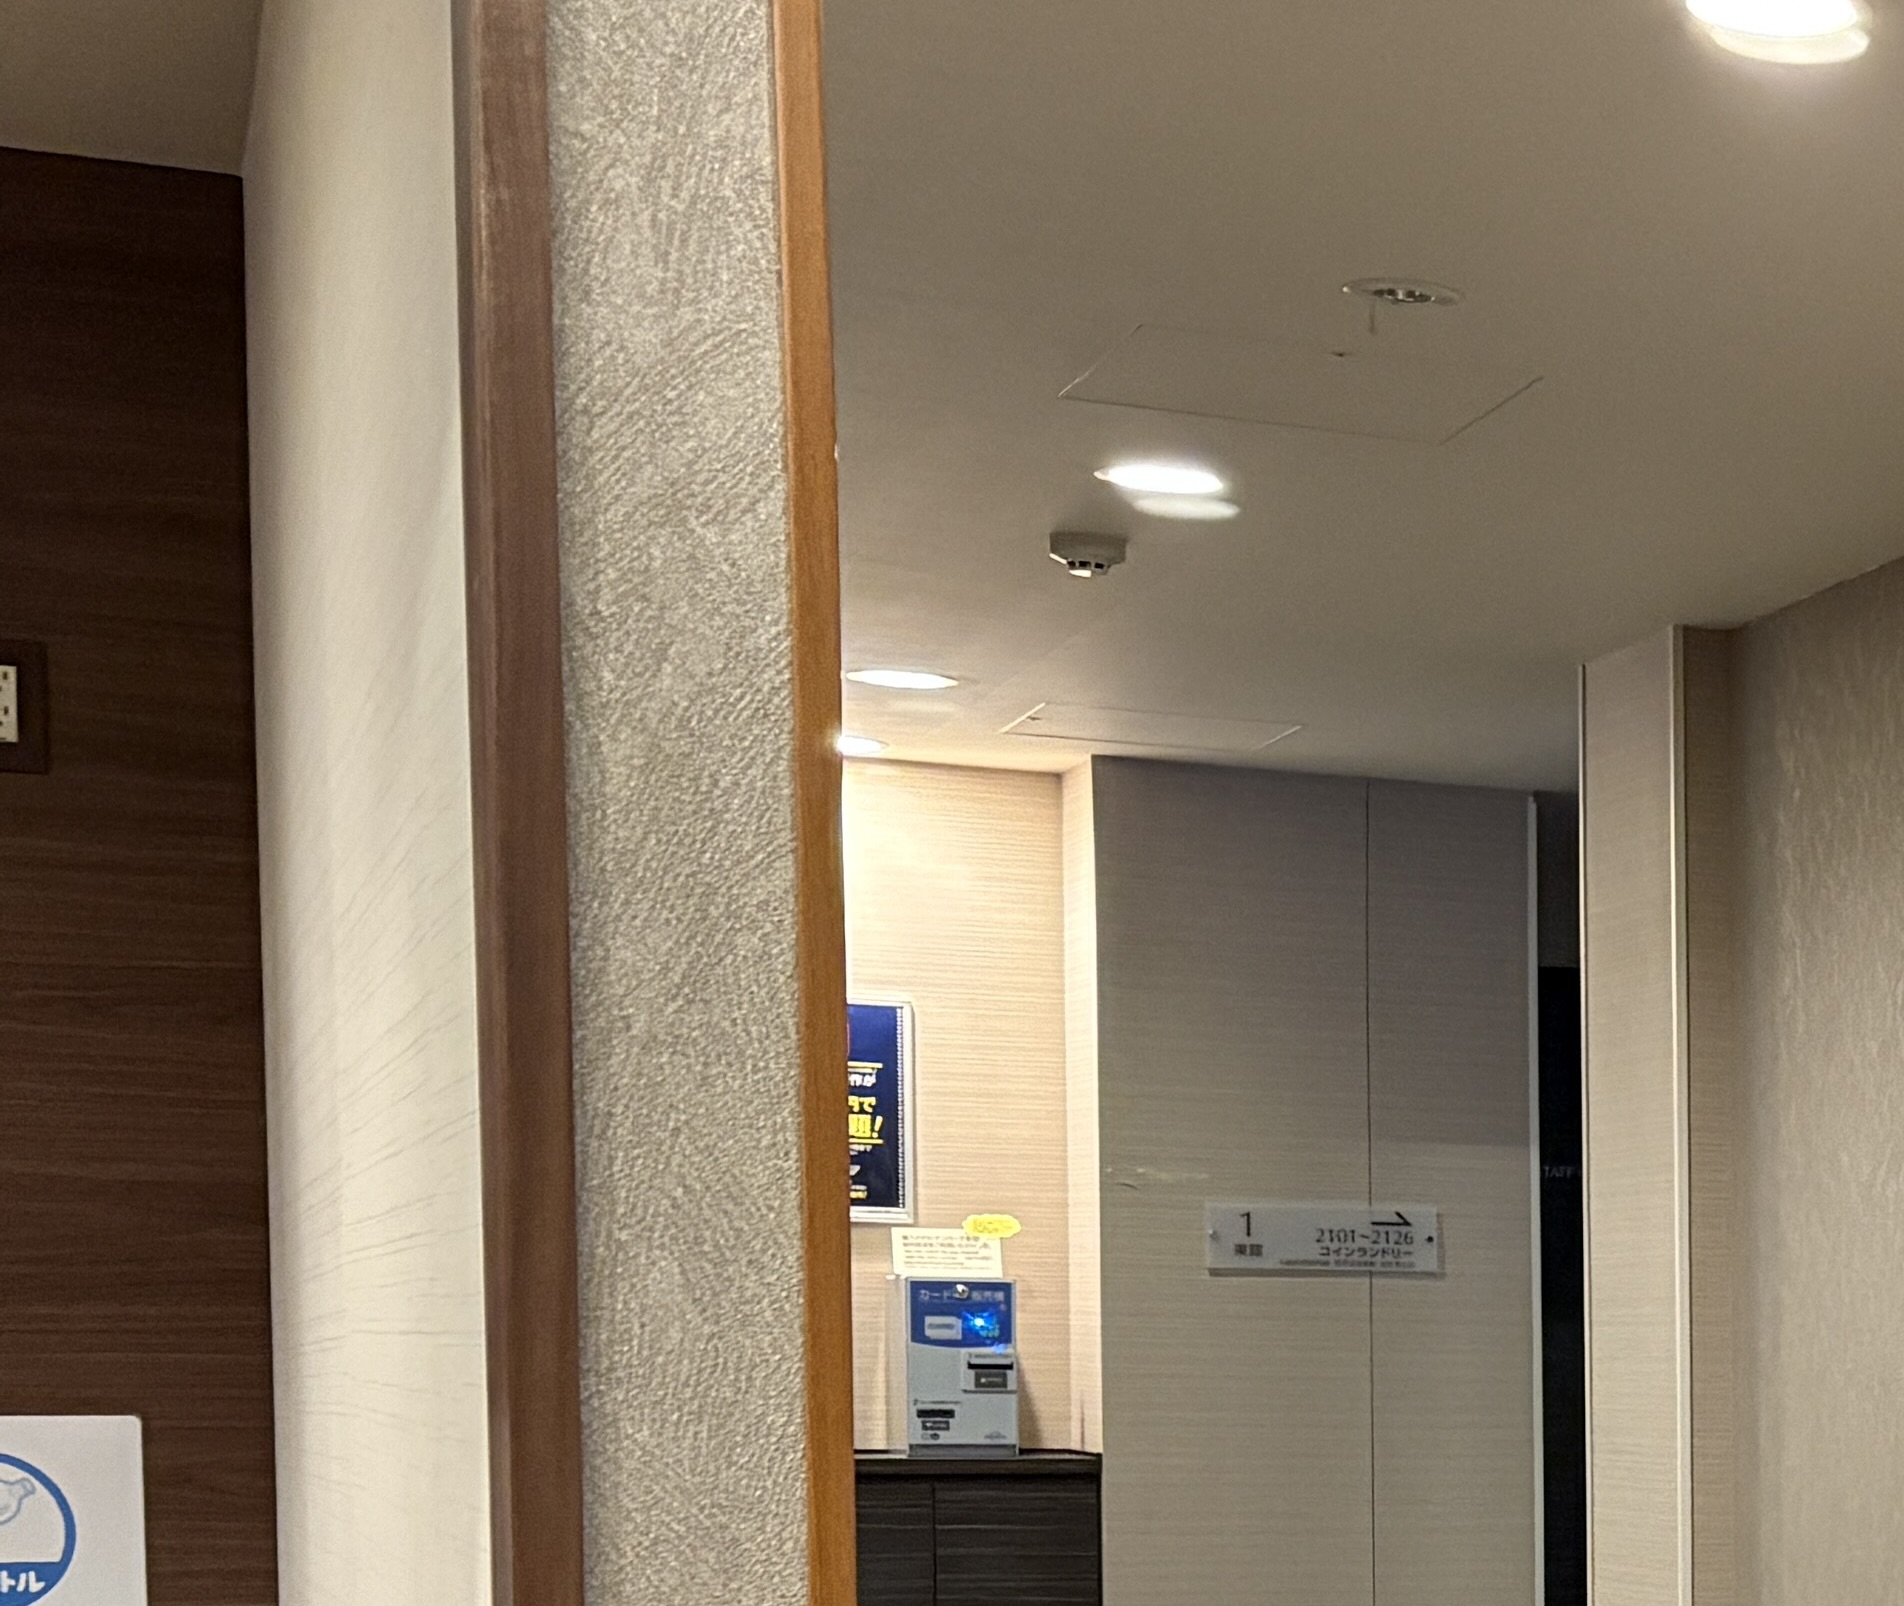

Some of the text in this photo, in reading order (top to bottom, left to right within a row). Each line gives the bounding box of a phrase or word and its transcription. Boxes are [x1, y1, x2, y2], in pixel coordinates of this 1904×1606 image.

[1239, 1211, 1251, 1237] 1
[1319, 1246, 1415, 1259] コインランドリー
